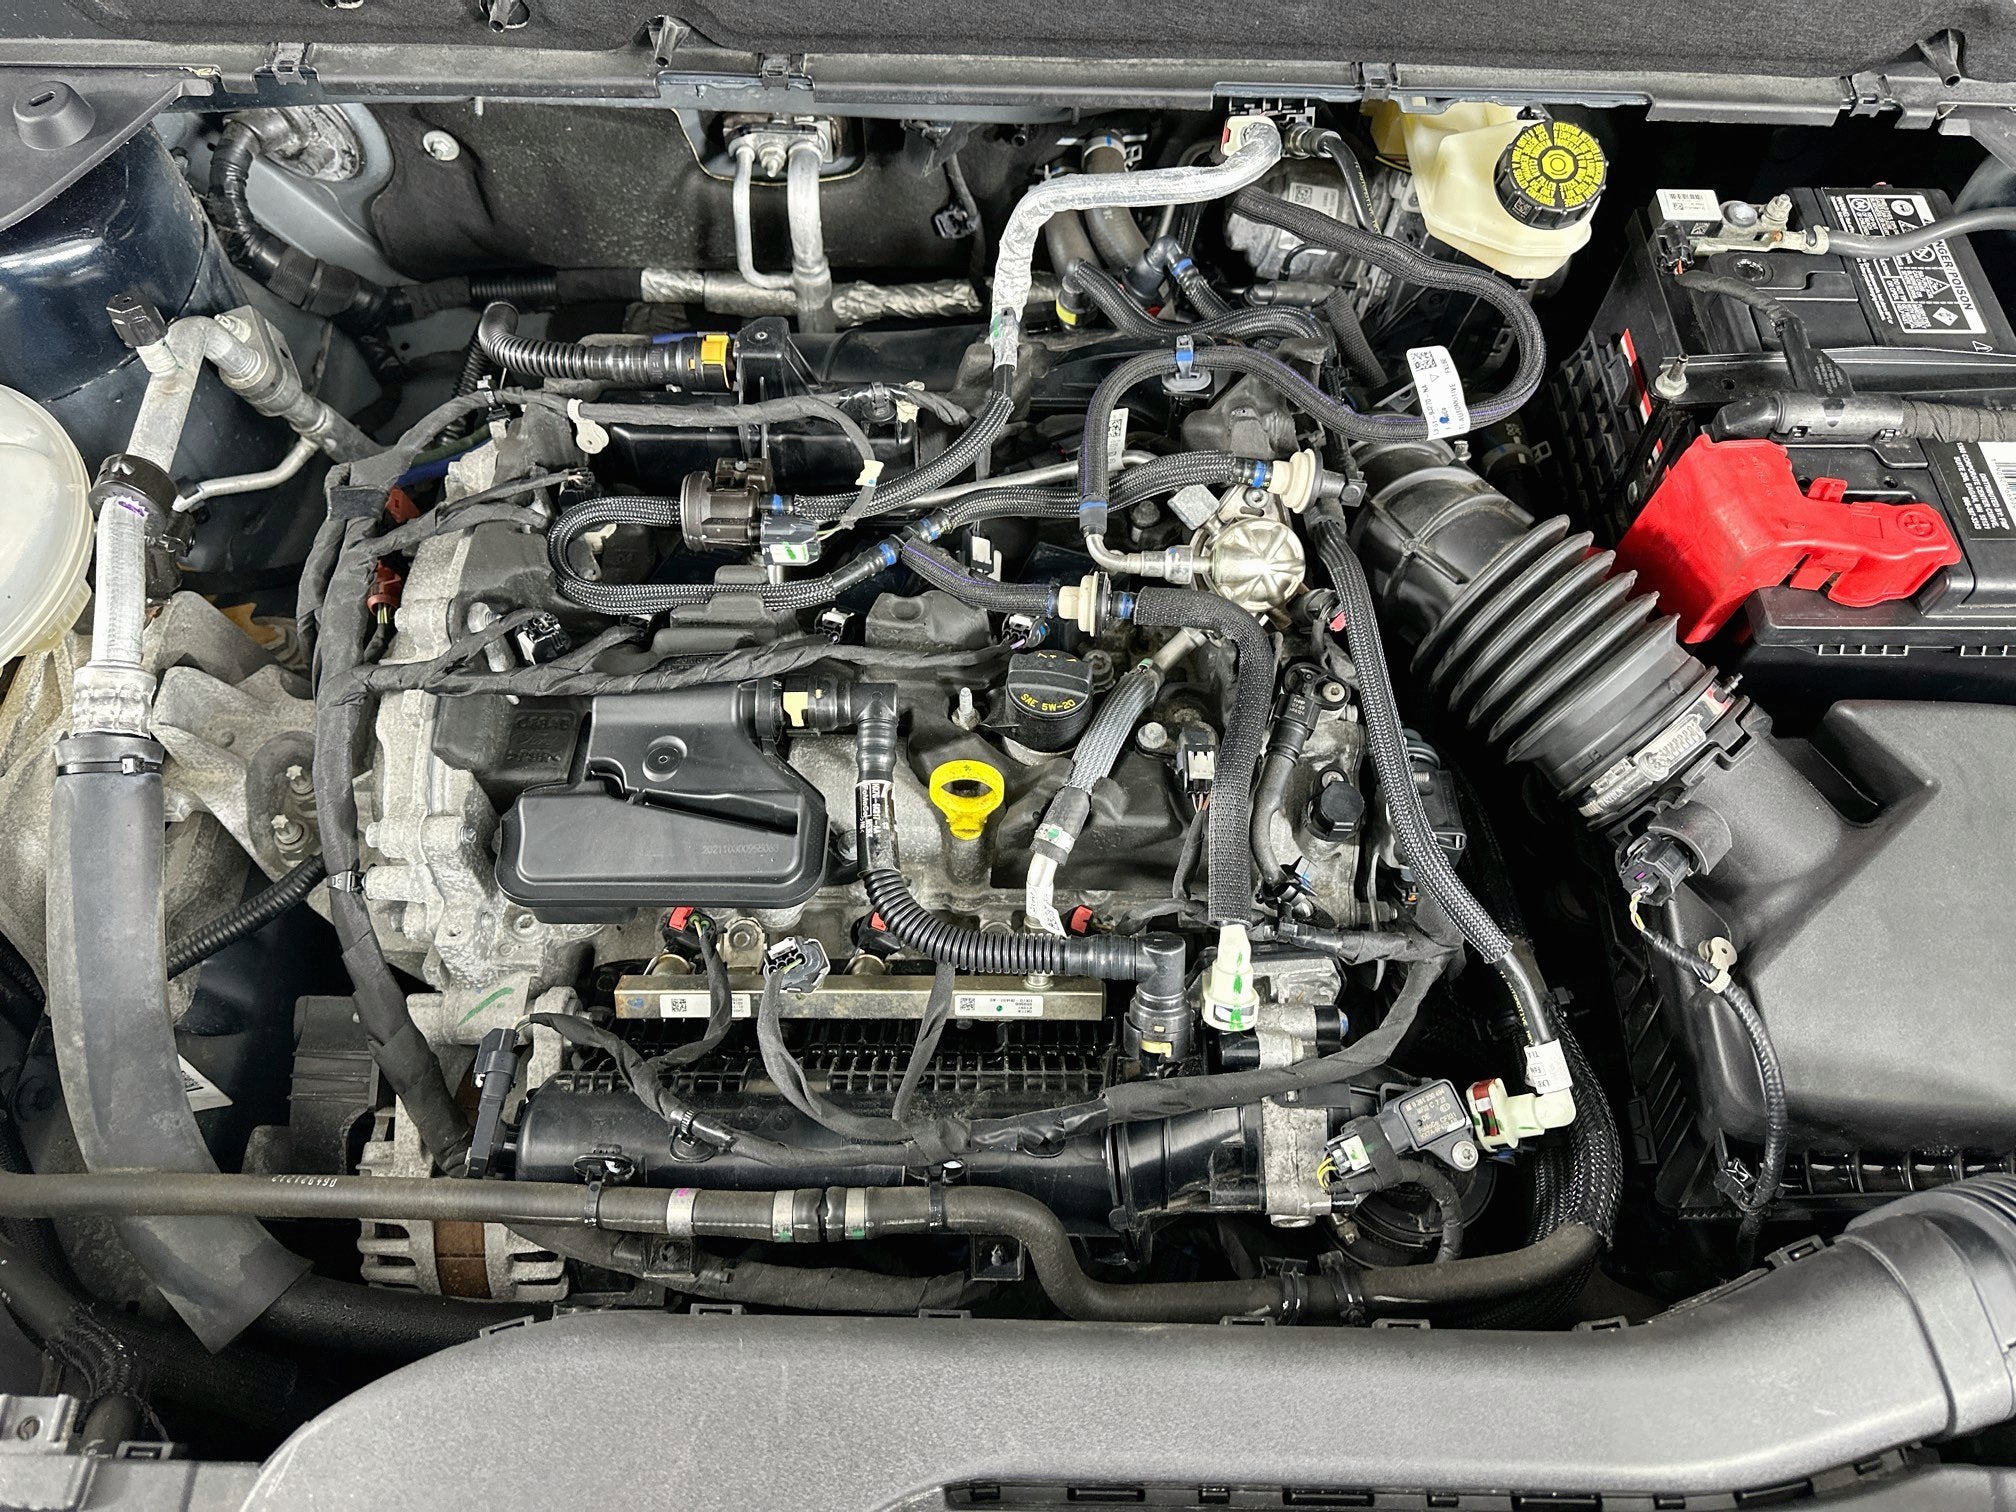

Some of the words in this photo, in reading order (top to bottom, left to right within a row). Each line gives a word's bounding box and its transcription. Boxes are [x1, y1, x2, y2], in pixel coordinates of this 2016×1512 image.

[1954, 456, 1966, 472] SUITE
[1961, 453, 1981, 485] CORPORATE
[1975, 486, 1991, 508] CENTER
[1020, 694, 1038, 707] SAE
[1041, 700, 1076, 712] 5W-20
[1506, 982, 1528, 1027] AUTOMOTIVE
